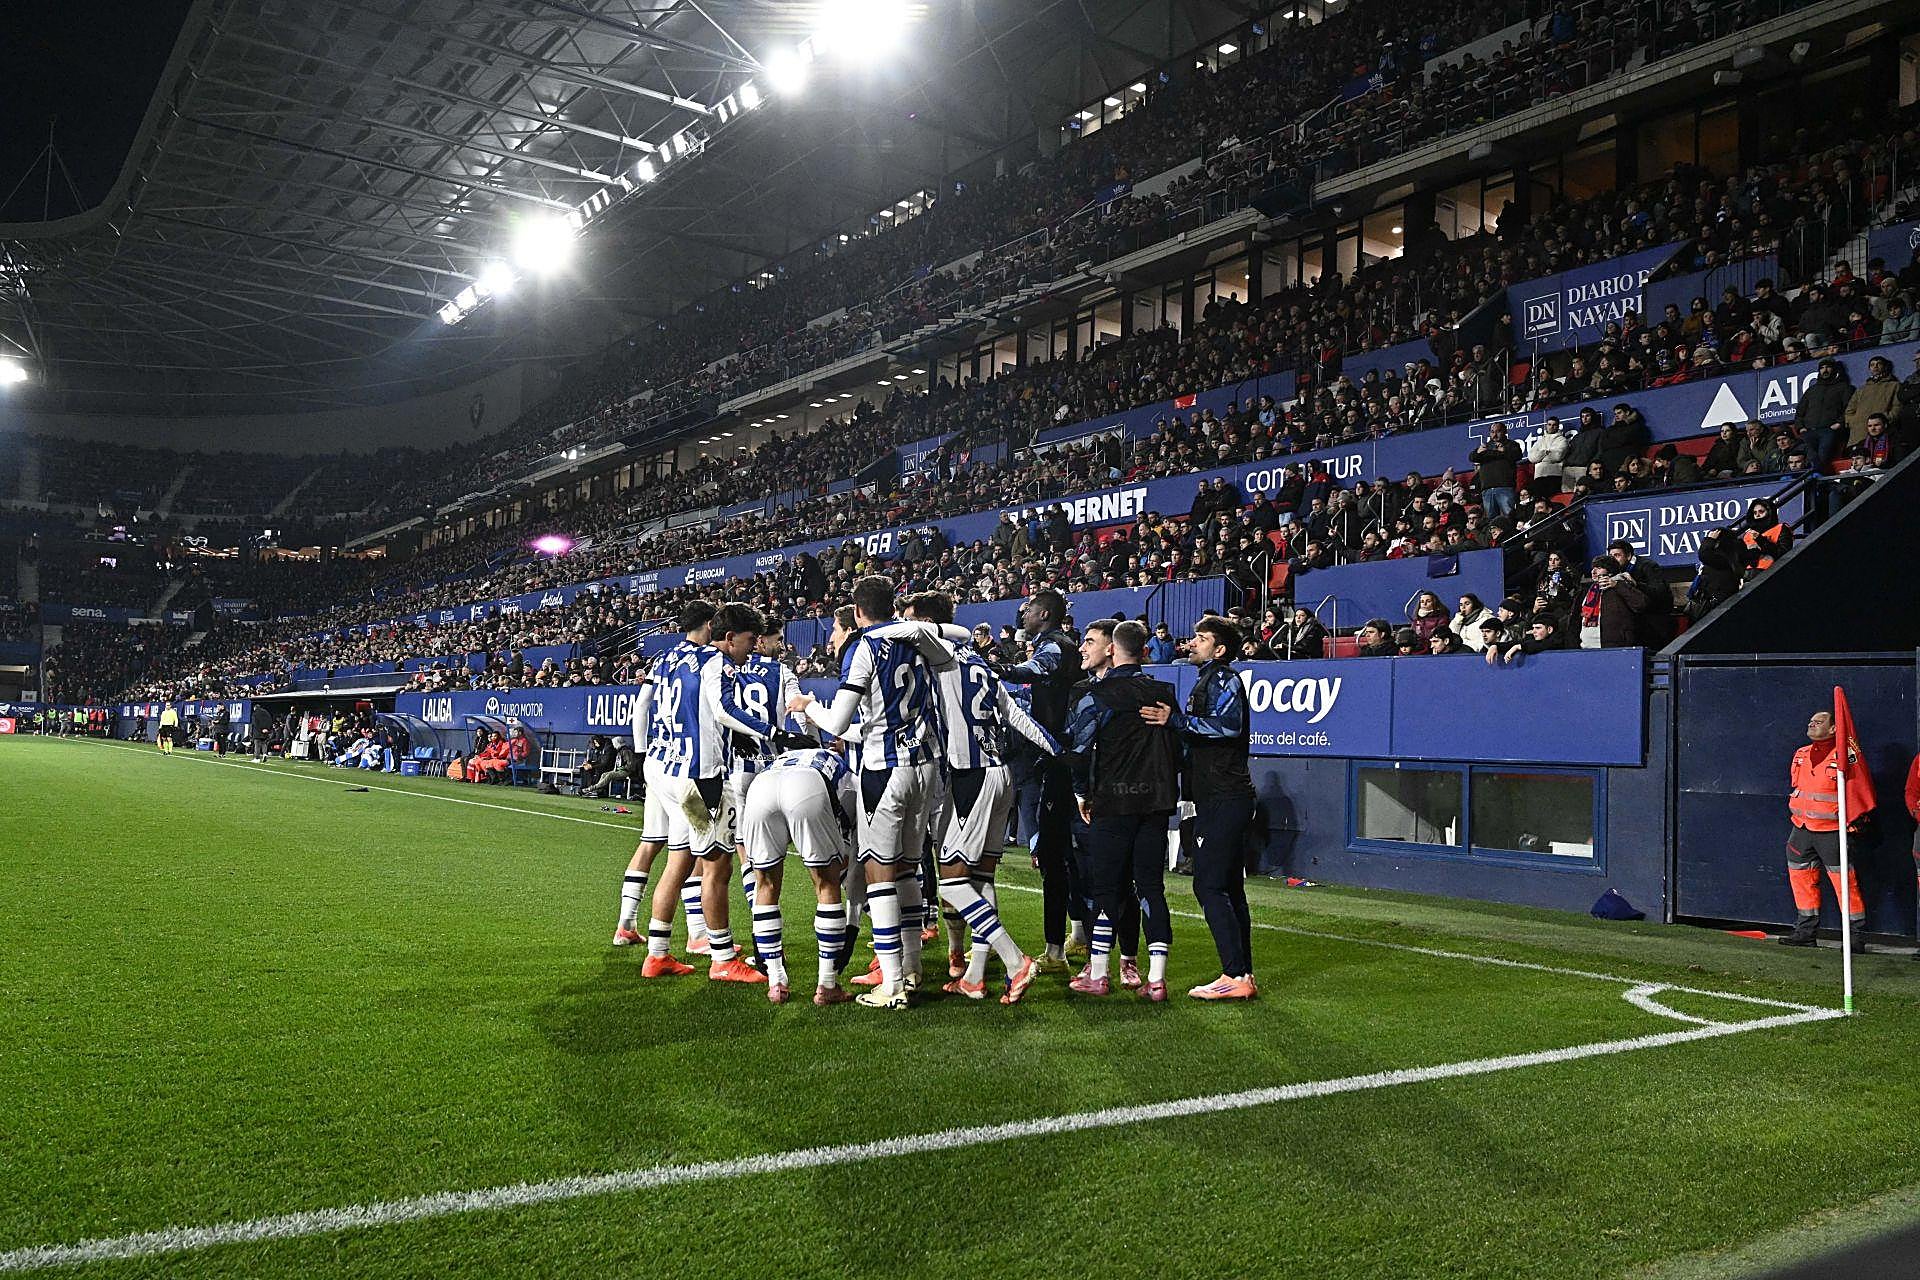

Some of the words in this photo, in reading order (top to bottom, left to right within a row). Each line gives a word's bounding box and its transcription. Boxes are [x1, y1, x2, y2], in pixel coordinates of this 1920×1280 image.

[1567, 273, 1634, 306] DIARIO
[1529, 301, 1555, 324] DN
[1659, 499, 1742, 527] DIARIO
[1612, 519, 1645, 541] DN
[695, 567, 725, 581] EUROCAM
[71, 606, 107, 618] sena.
[422, 697, 452, 722] LALIGA
[501, 703, 520, 717] TAURO
[520, 702, 544, 717] MOTOR
[587, 694, 634, 725] LALIGA
[1277, 731, 1296, 745] del
[1298, 731, 1331, 746] café.
[727, 807, 737, 830] 2
